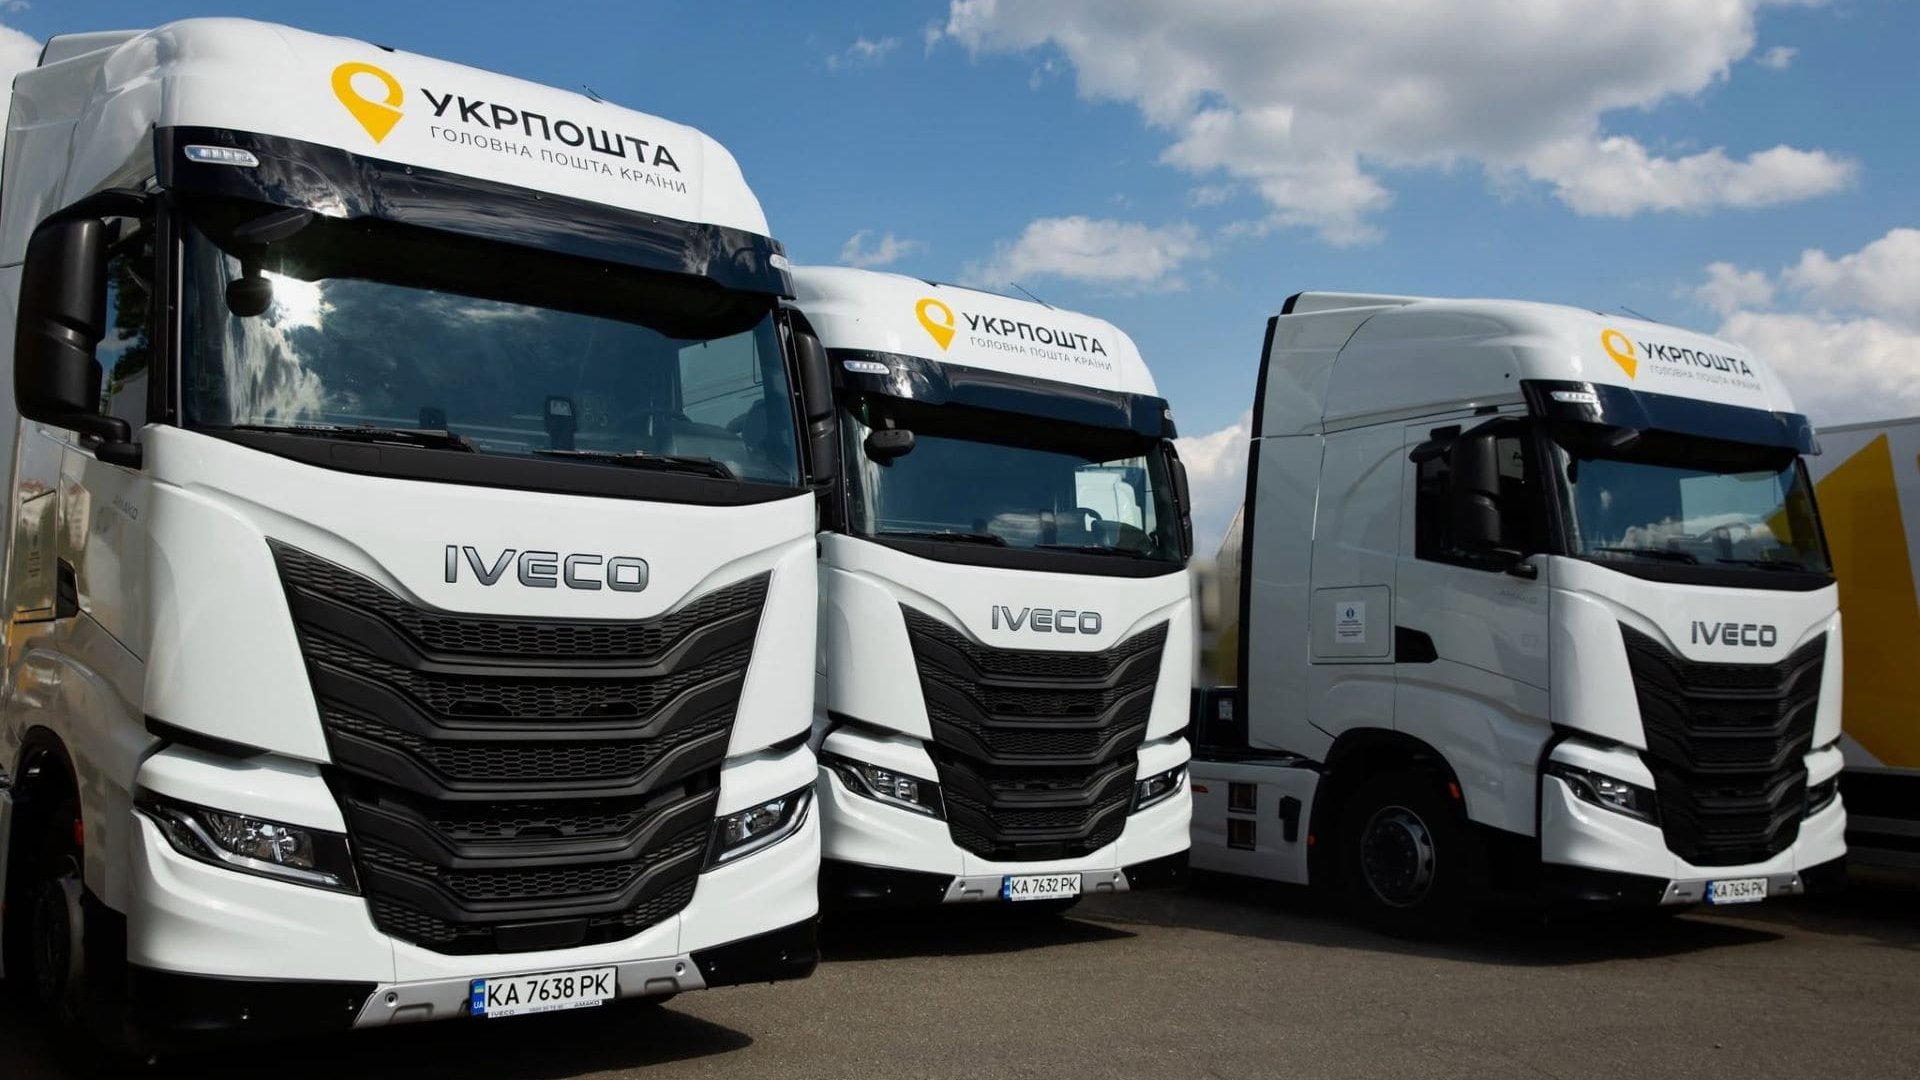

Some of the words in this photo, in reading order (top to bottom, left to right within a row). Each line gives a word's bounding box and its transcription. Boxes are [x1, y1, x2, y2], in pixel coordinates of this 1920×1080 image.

[420, 88, 681, 173] УКРПОШТА
[430, 126, 533, 159] ГОЛОВНА
[541, 149, 613, 176] ПОШТА
[620, 167, 687, 194] КРАЇНИ
[962, 312, 1107, 357] УКРПОШТА
[970, 336, 1025, 354] ГОЛОВНА
[1030, 347, 1070, 363] ПОШТА
[1638, 341, 1754, 378] УКРПОШТА
[444, 544, 649, 592] IVECO
[991, 605, 1102, 635] IVECO
[1691, 620, 1777, 647] IVECO
[1011, 880, 1029, 894] KA
[1032, 878, 1058, 893] 7632
[1060, 877, 1077, 892] PK
[1713, 884, 1727, 898] KA
[1729, 882, 1750, 897] 7634
[487, 982, 520, 1007] KA
[526, 976, 574, 1003] 7638
[580, 972, 609, 997] PK
[473, 1001, 484, 1009] UA
[490, 1009, 515, 1017] IVECO
